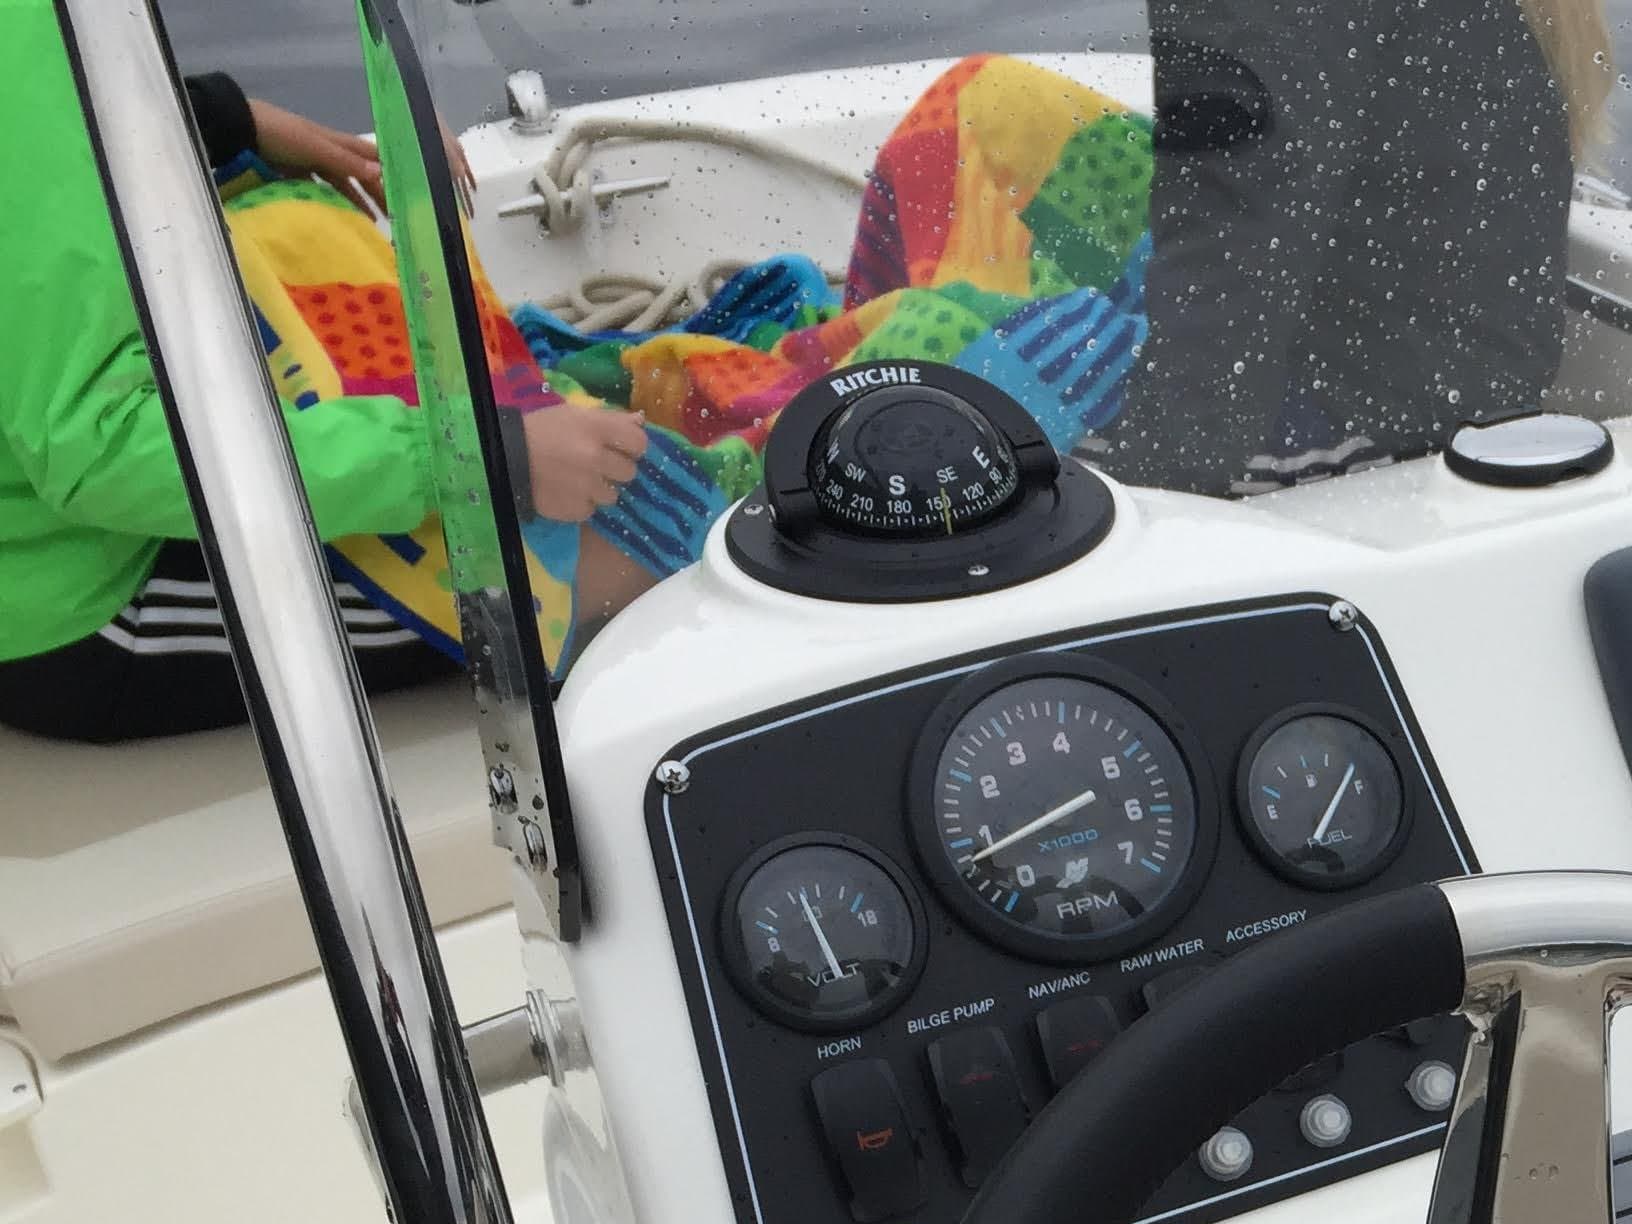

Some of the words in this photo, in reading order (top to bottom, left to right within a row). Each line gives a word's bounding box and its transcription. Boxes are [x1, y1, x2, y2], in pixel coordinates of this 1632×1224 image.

[830, 367, 921, 397] RITCHIE
[845, 462, 866, 482] SW
[888, 475, 906, 495] S
[936, 466, 958, 484] SE
[972, 445, 990, 469] E
[826, 479, 844, 500] 240
[850, 494, 873, 511] 210
[887, 500, 912, 514] 180
[926, 497, 951, 511] 150
[962, 482, 984, 501] 120
[989, 466, 1003, 484] 90
[1007, 742, 1027, 765] 3
[1052, 732, 1071, 754] 4
[1101, 756, 1120, 780] 5
[979, 775, 1000, 798] 2
[1354, 779, 1364, 795] F
[1124, 799, 1144, 821] 6
[1267, 804, 1279, 820] E
[978, 825, 995, 847] 1
[1039, 829, 1098, 852] X1000
[1307, 829, 1352, 848] FUEL
[1117, 841, 1134, 864] 7
[1016, 865, 1036, 887] 0
[1056, 890, 1118, 919] RPM
[858, 909, 878, 928] 18
[1225, 910, 1308, 944] ACCESSORY
[767, 937, 781, 953] 8
[1120, 954, 1154, 973] RAW
[1154, 938, 1205, 968] WATER
[807, 962, 861, 987] VOLT
[1028, 972, 1091, 999] NAV/ANC
[907, 1008, 951, 1034] BILGE
[954, 998, 996, 1024] PUMP
[817, 1036, 862, 1059] HORN
